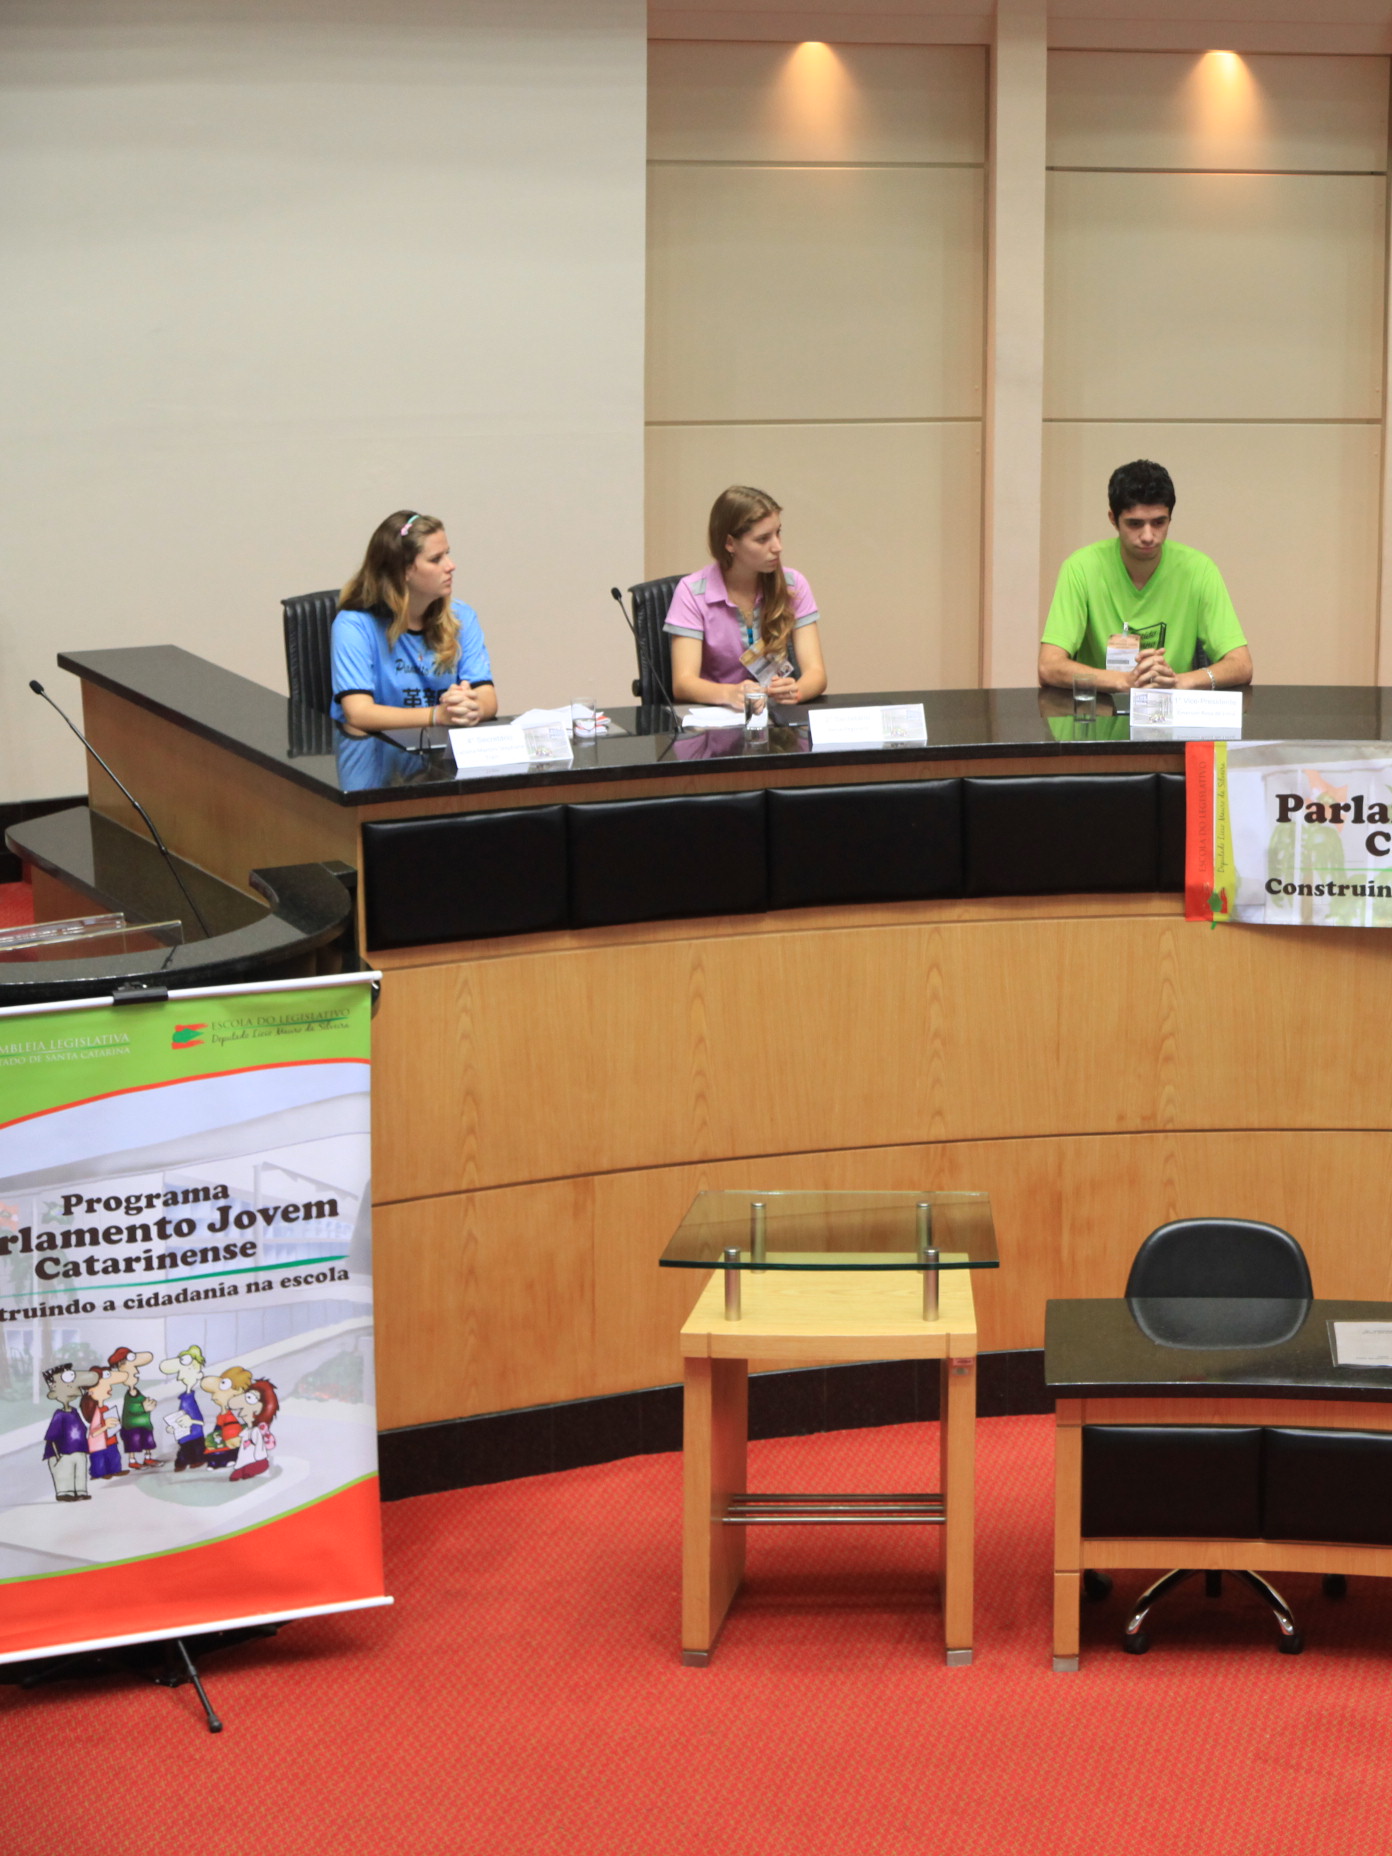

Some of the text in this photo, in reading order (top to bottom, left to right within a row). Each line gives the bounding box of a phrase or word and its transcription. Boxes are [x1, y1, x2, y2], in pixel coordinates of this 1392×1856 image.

[29, 1055, 42, 1063] DE
[45, 1052, 78, 1063] SANTA
[80, 1047, 130, 1059] CATARINA
[50, 1033, 130, 1050] LEGISLATIVA
[61, 1184, 230, 1216] Programa
[207, 1198, 339, 1233] Jovem
[35, 1241, 257, 1281] Catarinense
[103, 1299, 116, 1312] a
[123, 1282, 239, 1310] cidadania
[246, 1279, 273, 1294] na
[280, 1266, 350, 1289] escola
